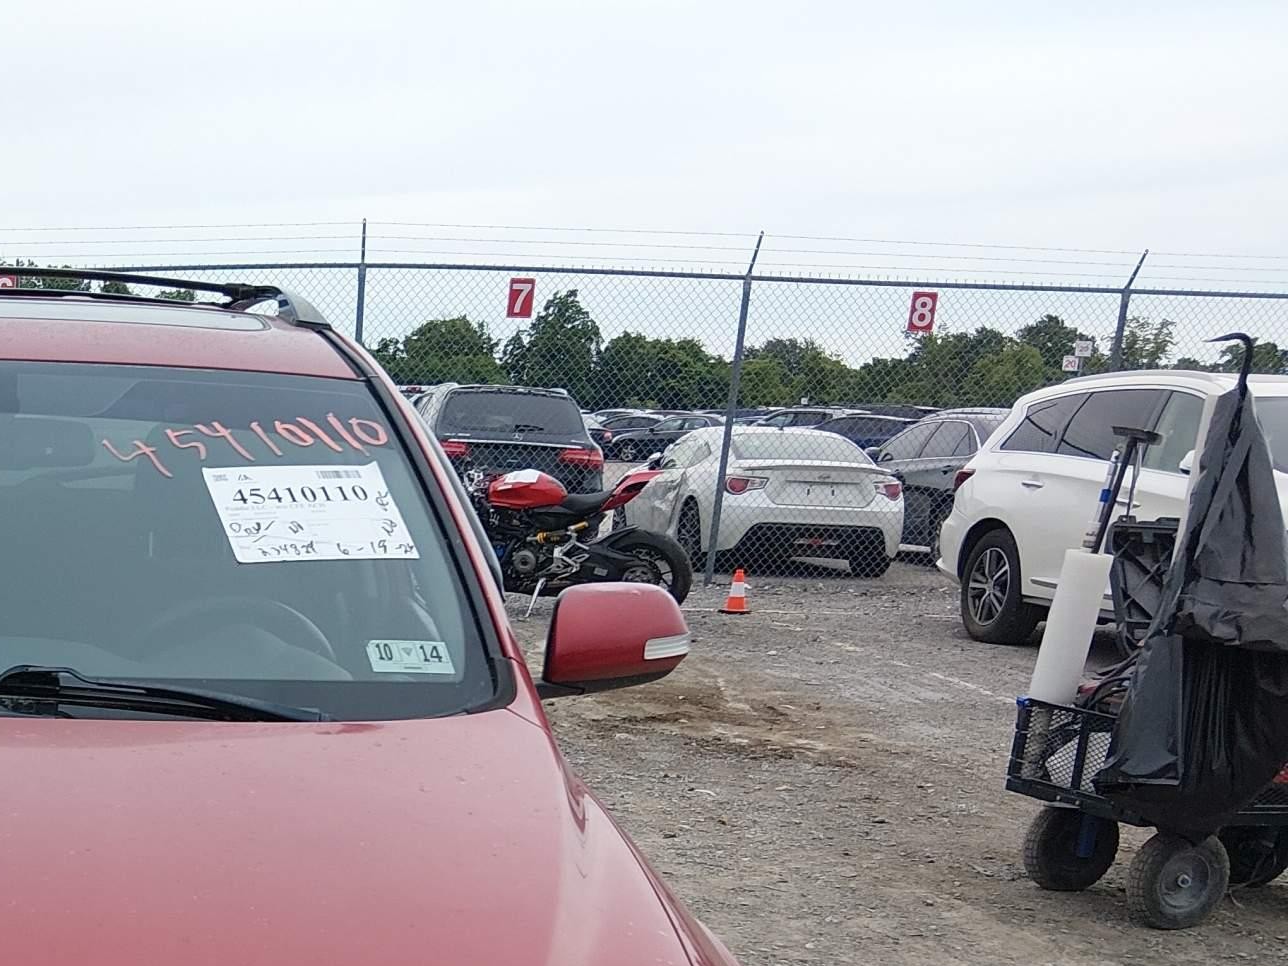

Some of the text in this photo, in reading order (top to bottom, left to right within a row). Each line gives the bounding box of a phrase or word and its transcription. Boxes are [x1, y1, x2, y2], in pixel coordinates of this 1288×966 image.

[512, 284, 532, 313] 7
[912, 296, 932, 327] 8
[232, 484, 369, 505] 45410110
[375, 643, 443, 663] 10 14
